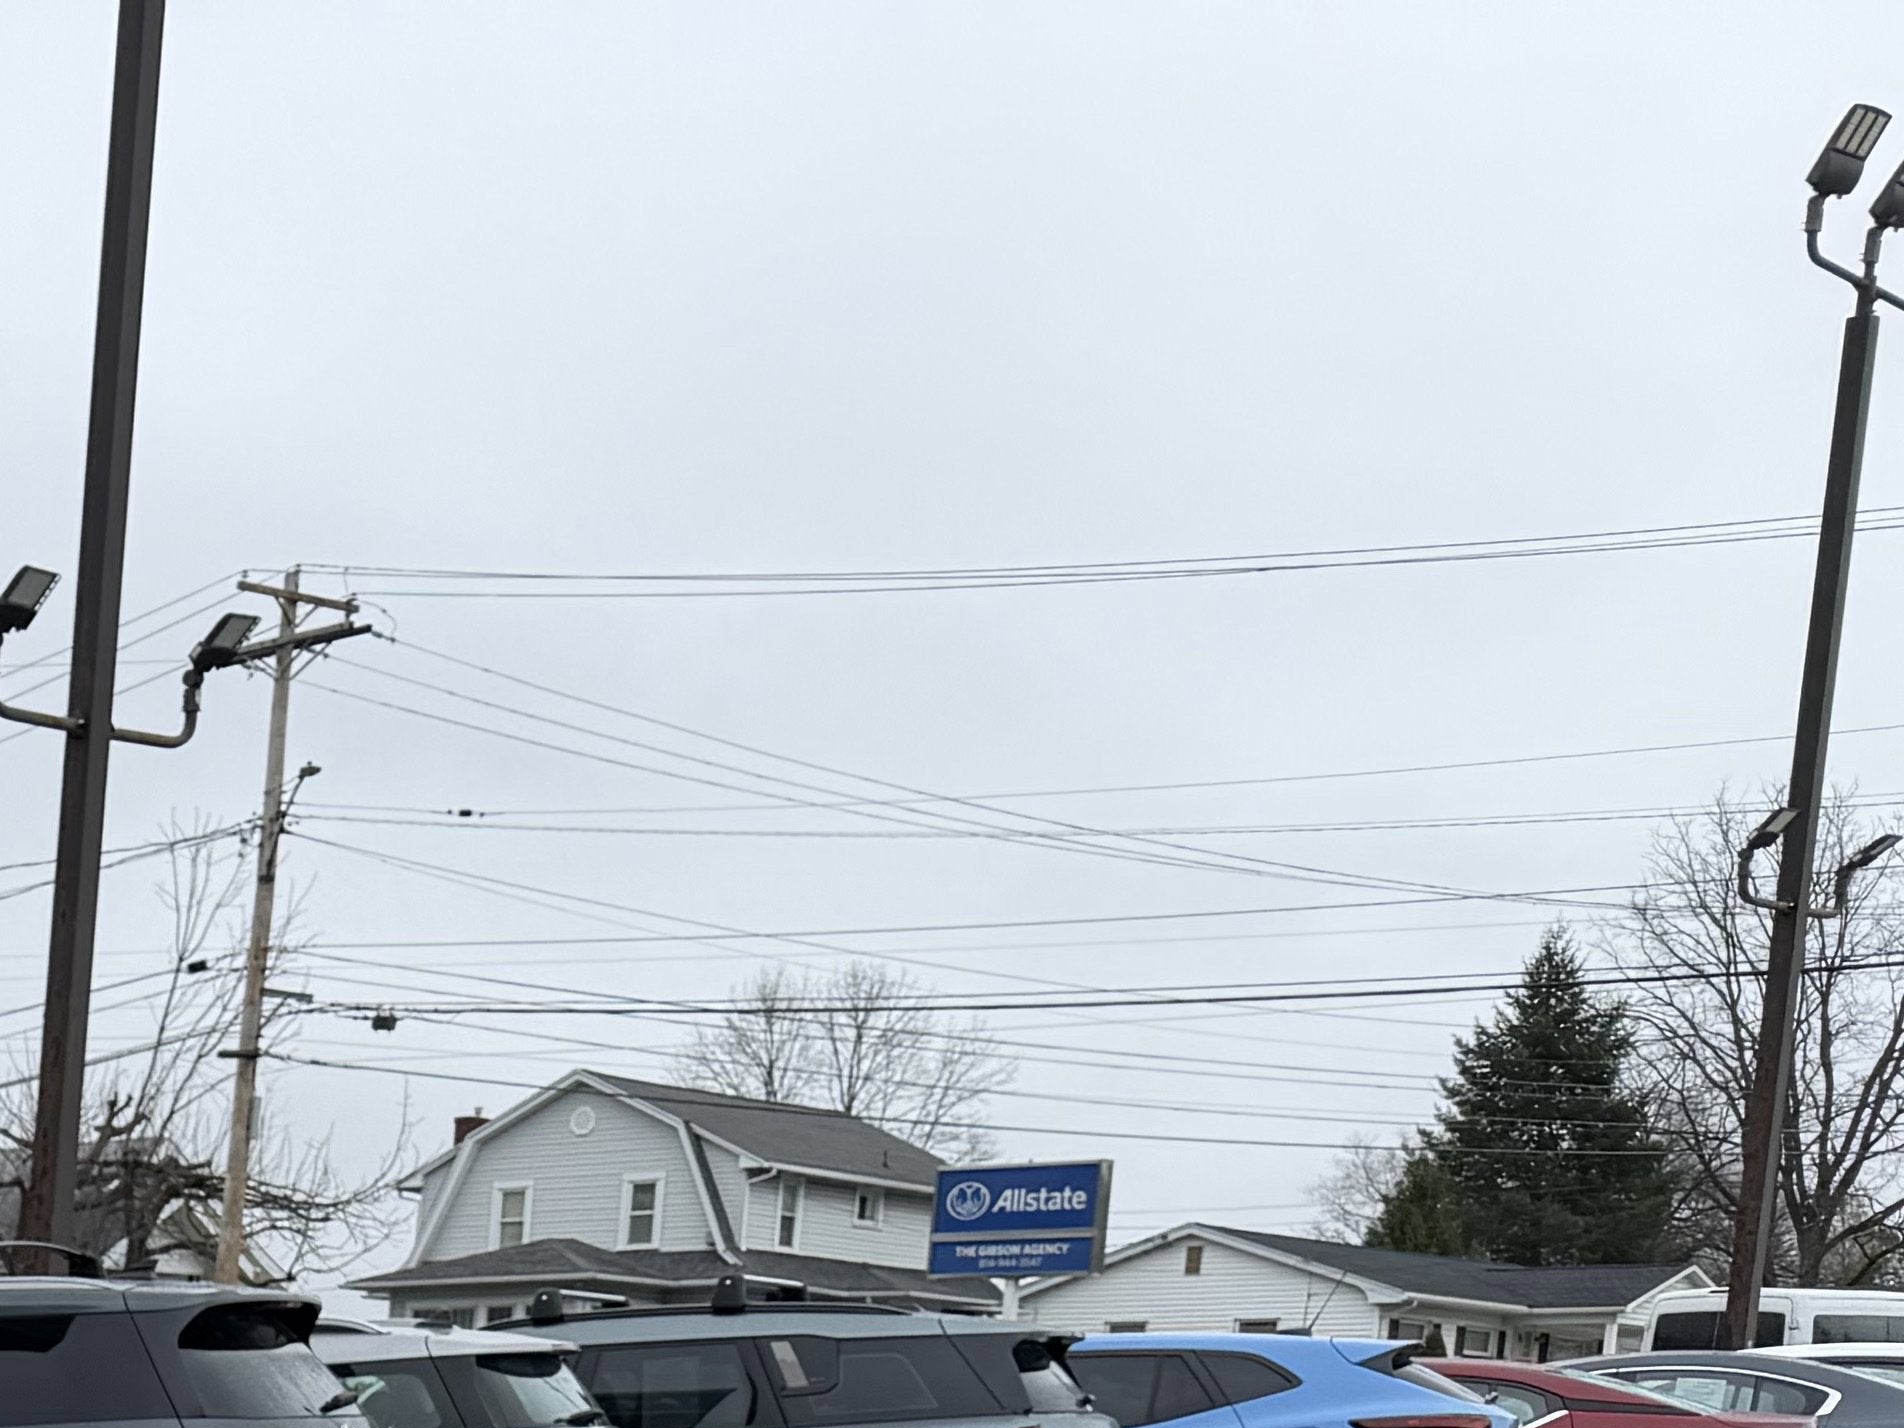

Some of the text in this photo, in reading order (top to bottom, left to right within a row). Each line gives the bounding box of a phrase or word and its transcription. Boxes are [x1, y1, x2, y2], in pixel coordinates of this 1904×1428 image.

[991, 1186, 1088, 1213] Allstate
[955, 1245, 977, 1257] THE
[1023, 1243, 1070, 1256] AGENCY
